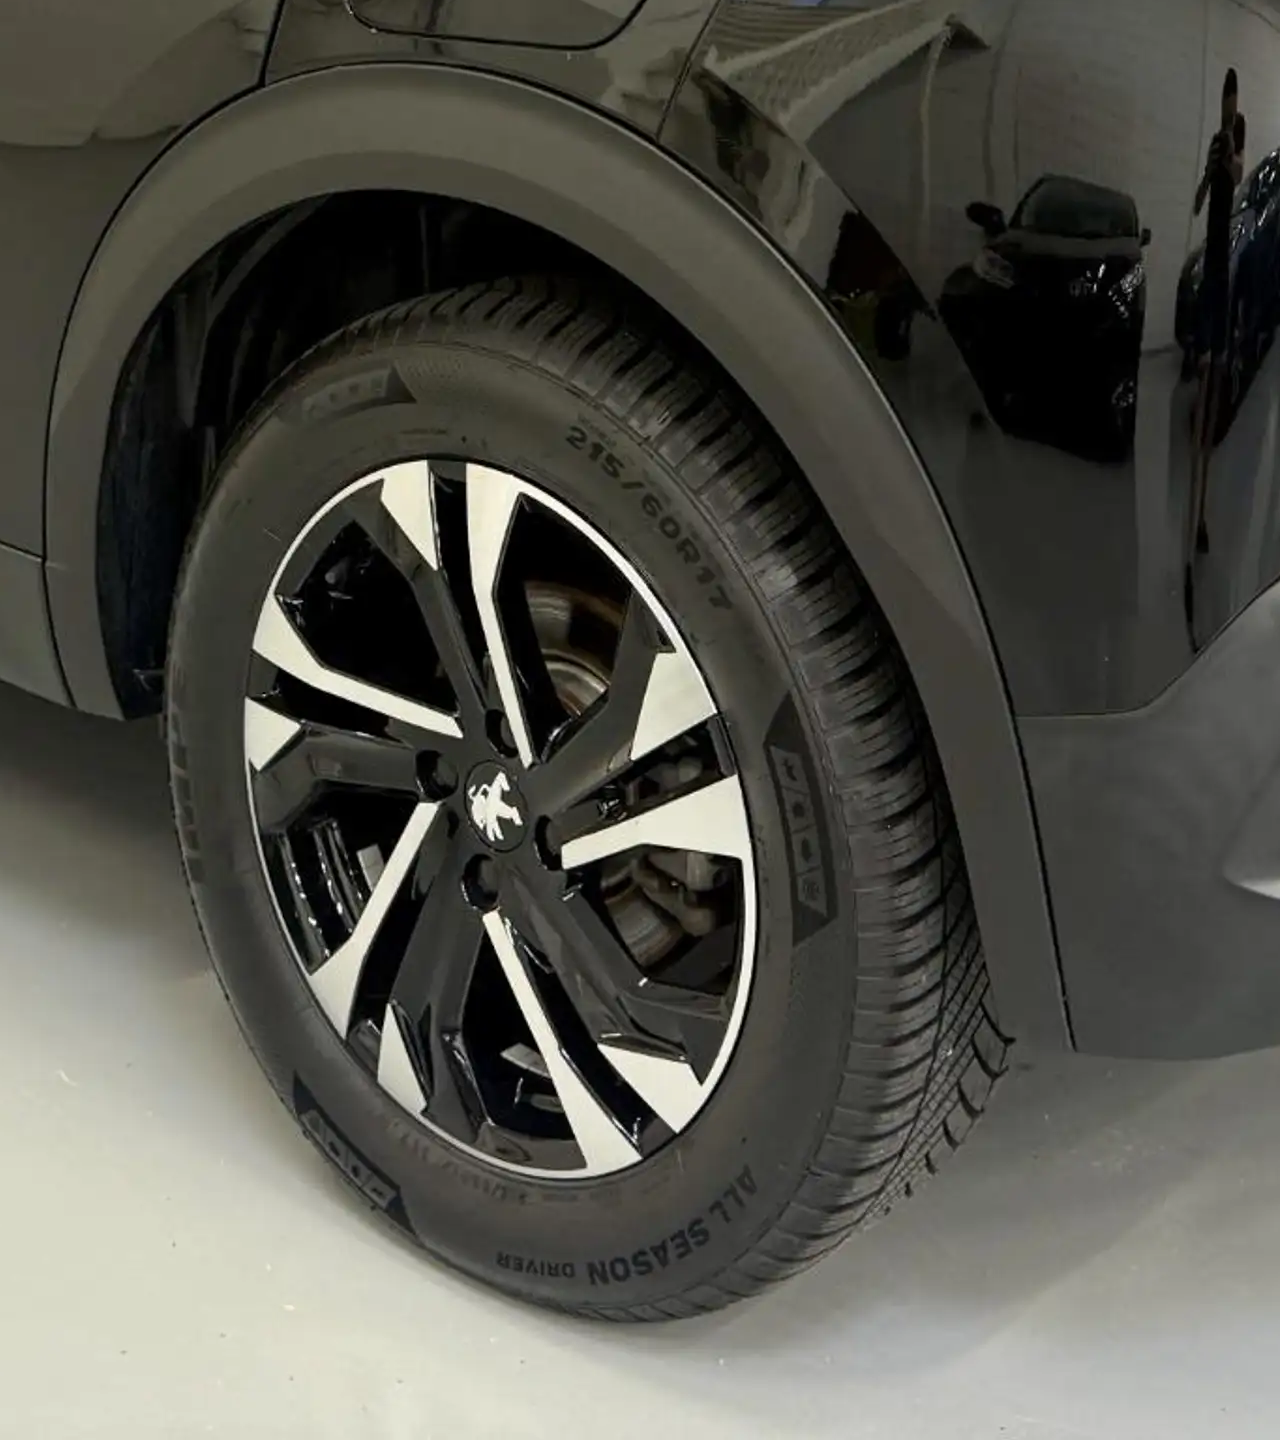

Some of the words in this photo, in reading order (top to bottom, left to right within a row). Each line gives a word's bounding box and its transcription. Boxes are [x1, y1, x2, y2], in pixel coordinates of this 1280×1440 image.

[565, 425, 734, 610] 215/60R17
[708, 1164, 758, 1224] ALL
[496, 1250, 576, 1279] DRIVER
[587, 1217, 711, 1286] SEASON
